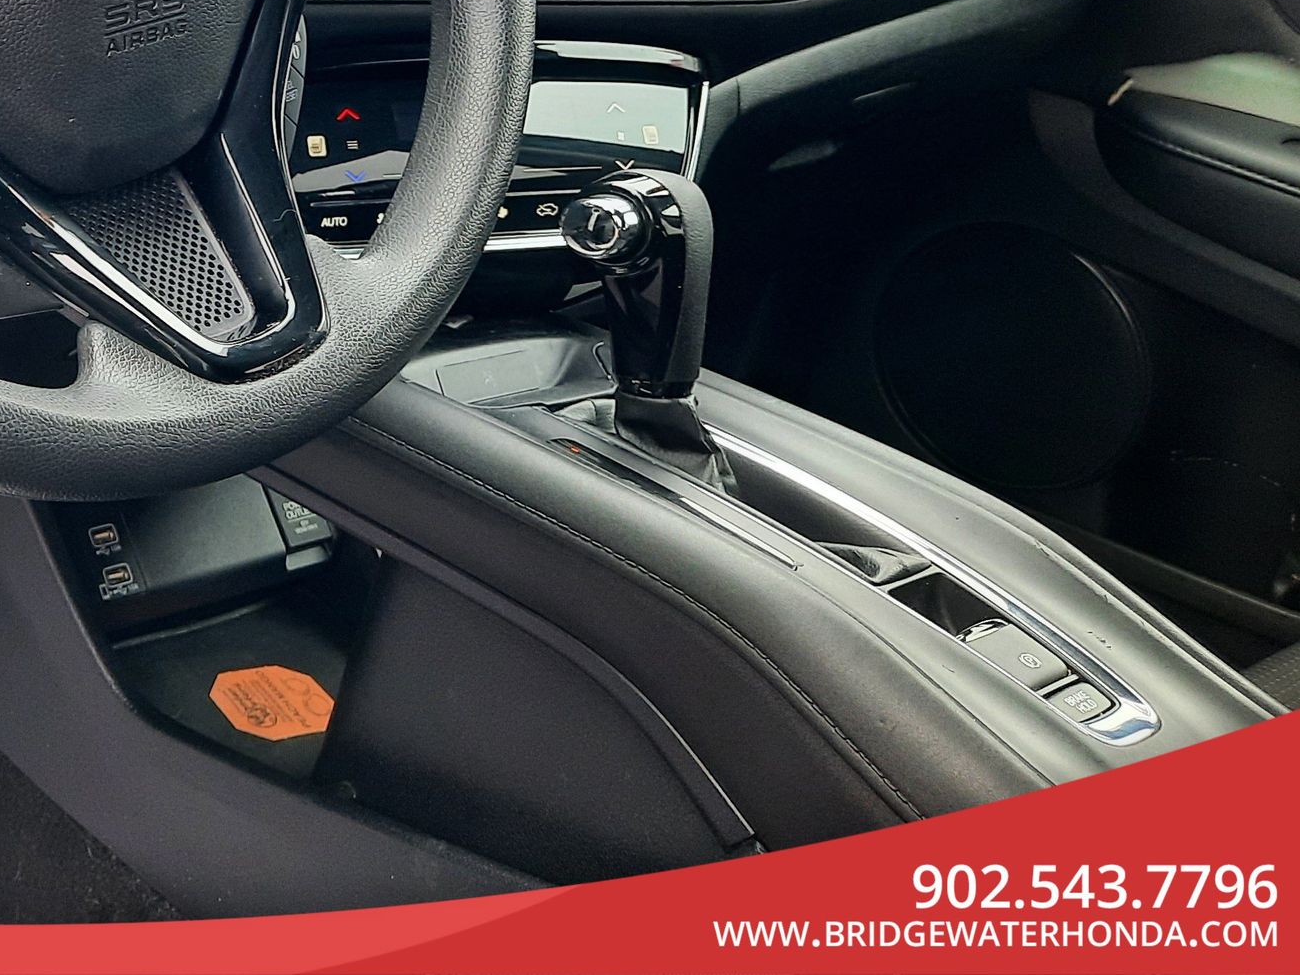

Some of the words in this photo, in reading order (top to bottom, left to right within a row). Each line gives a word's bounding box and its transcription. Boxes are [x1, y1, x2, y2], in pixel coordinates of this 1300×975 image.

[106, 20, 189, 58] AIRBAG
[321, 215, 348, 228] AUTO
[1064, 691, 1090, 706] BRAKE
[1075, 701, 1098, 714] HOLD
